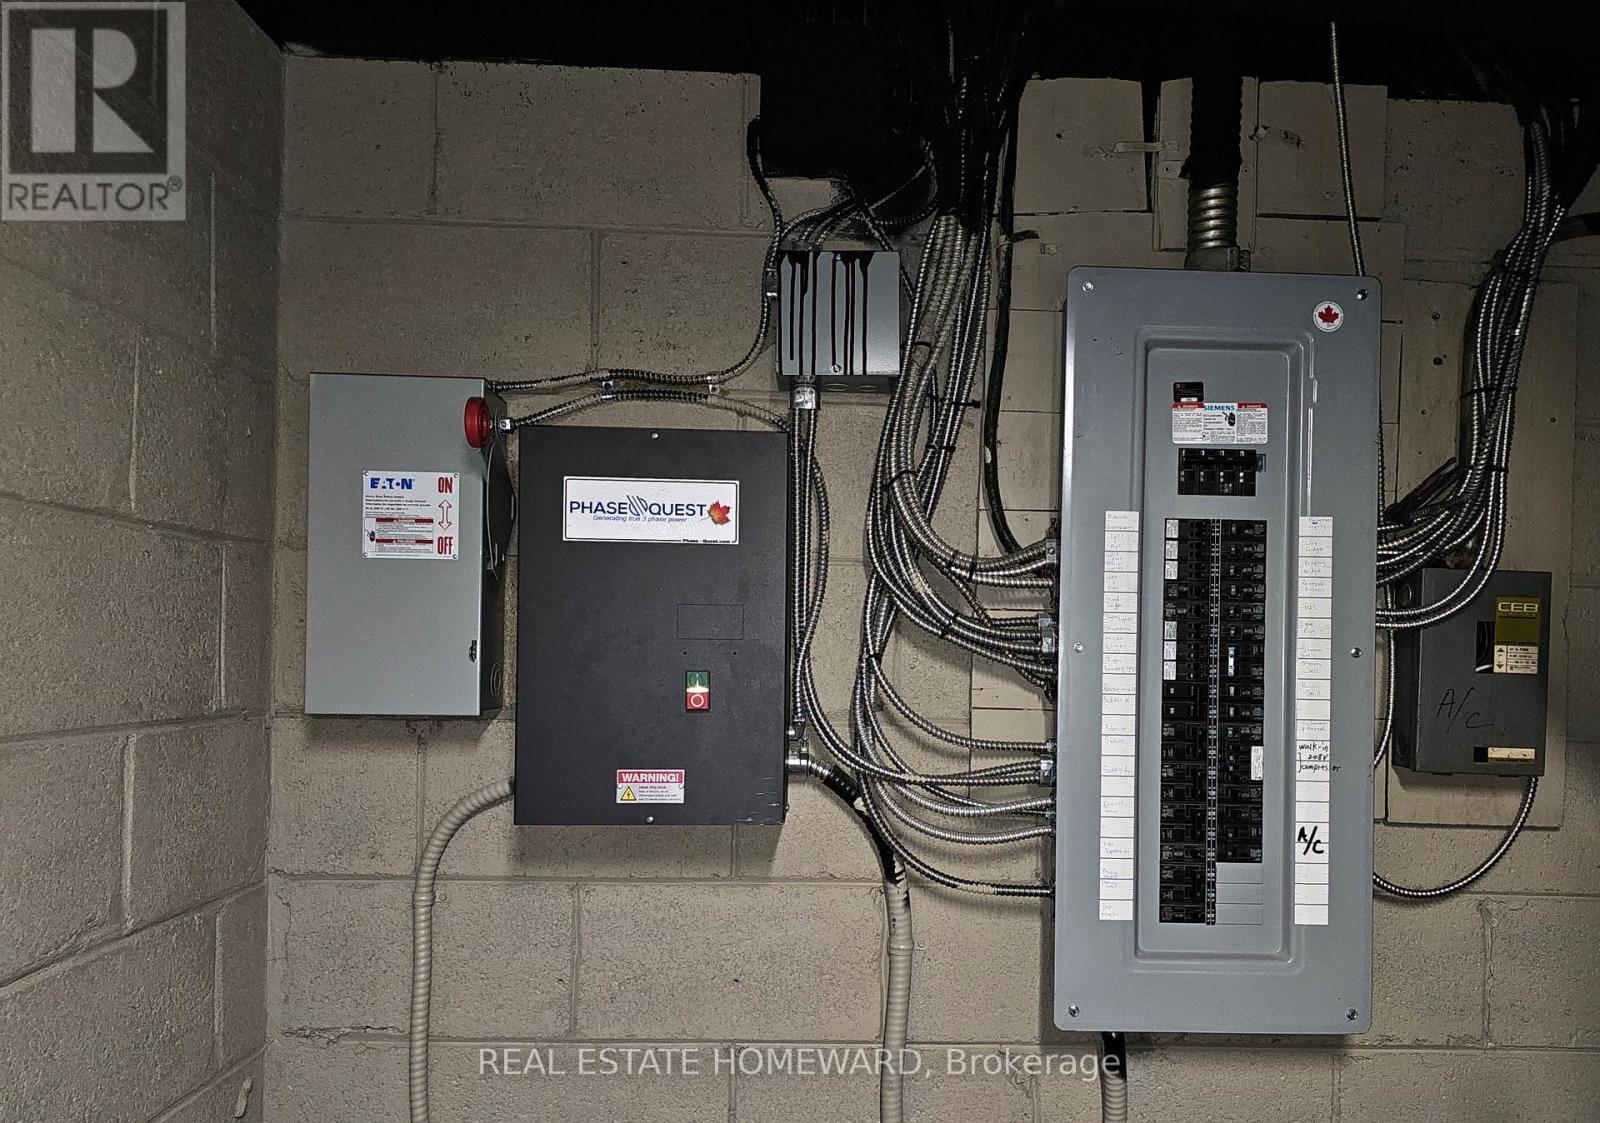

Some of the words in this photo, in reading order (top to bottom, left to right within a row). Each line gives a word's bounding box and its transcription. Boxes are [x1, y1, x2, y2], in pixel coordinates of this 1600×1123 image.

[437, 477, 453, 493] ON
[569, 501, 628, 515] PHASE
[648, 502, 707, 516] QUEST
[592, 514, 627, 522] Generating
[437, 536, 454, 555] OFF
[1436, 686, 1495, 733] A/C
[621, 772, 680, 783] WARNING!
[1297, 825, 1325, 856] A/C
